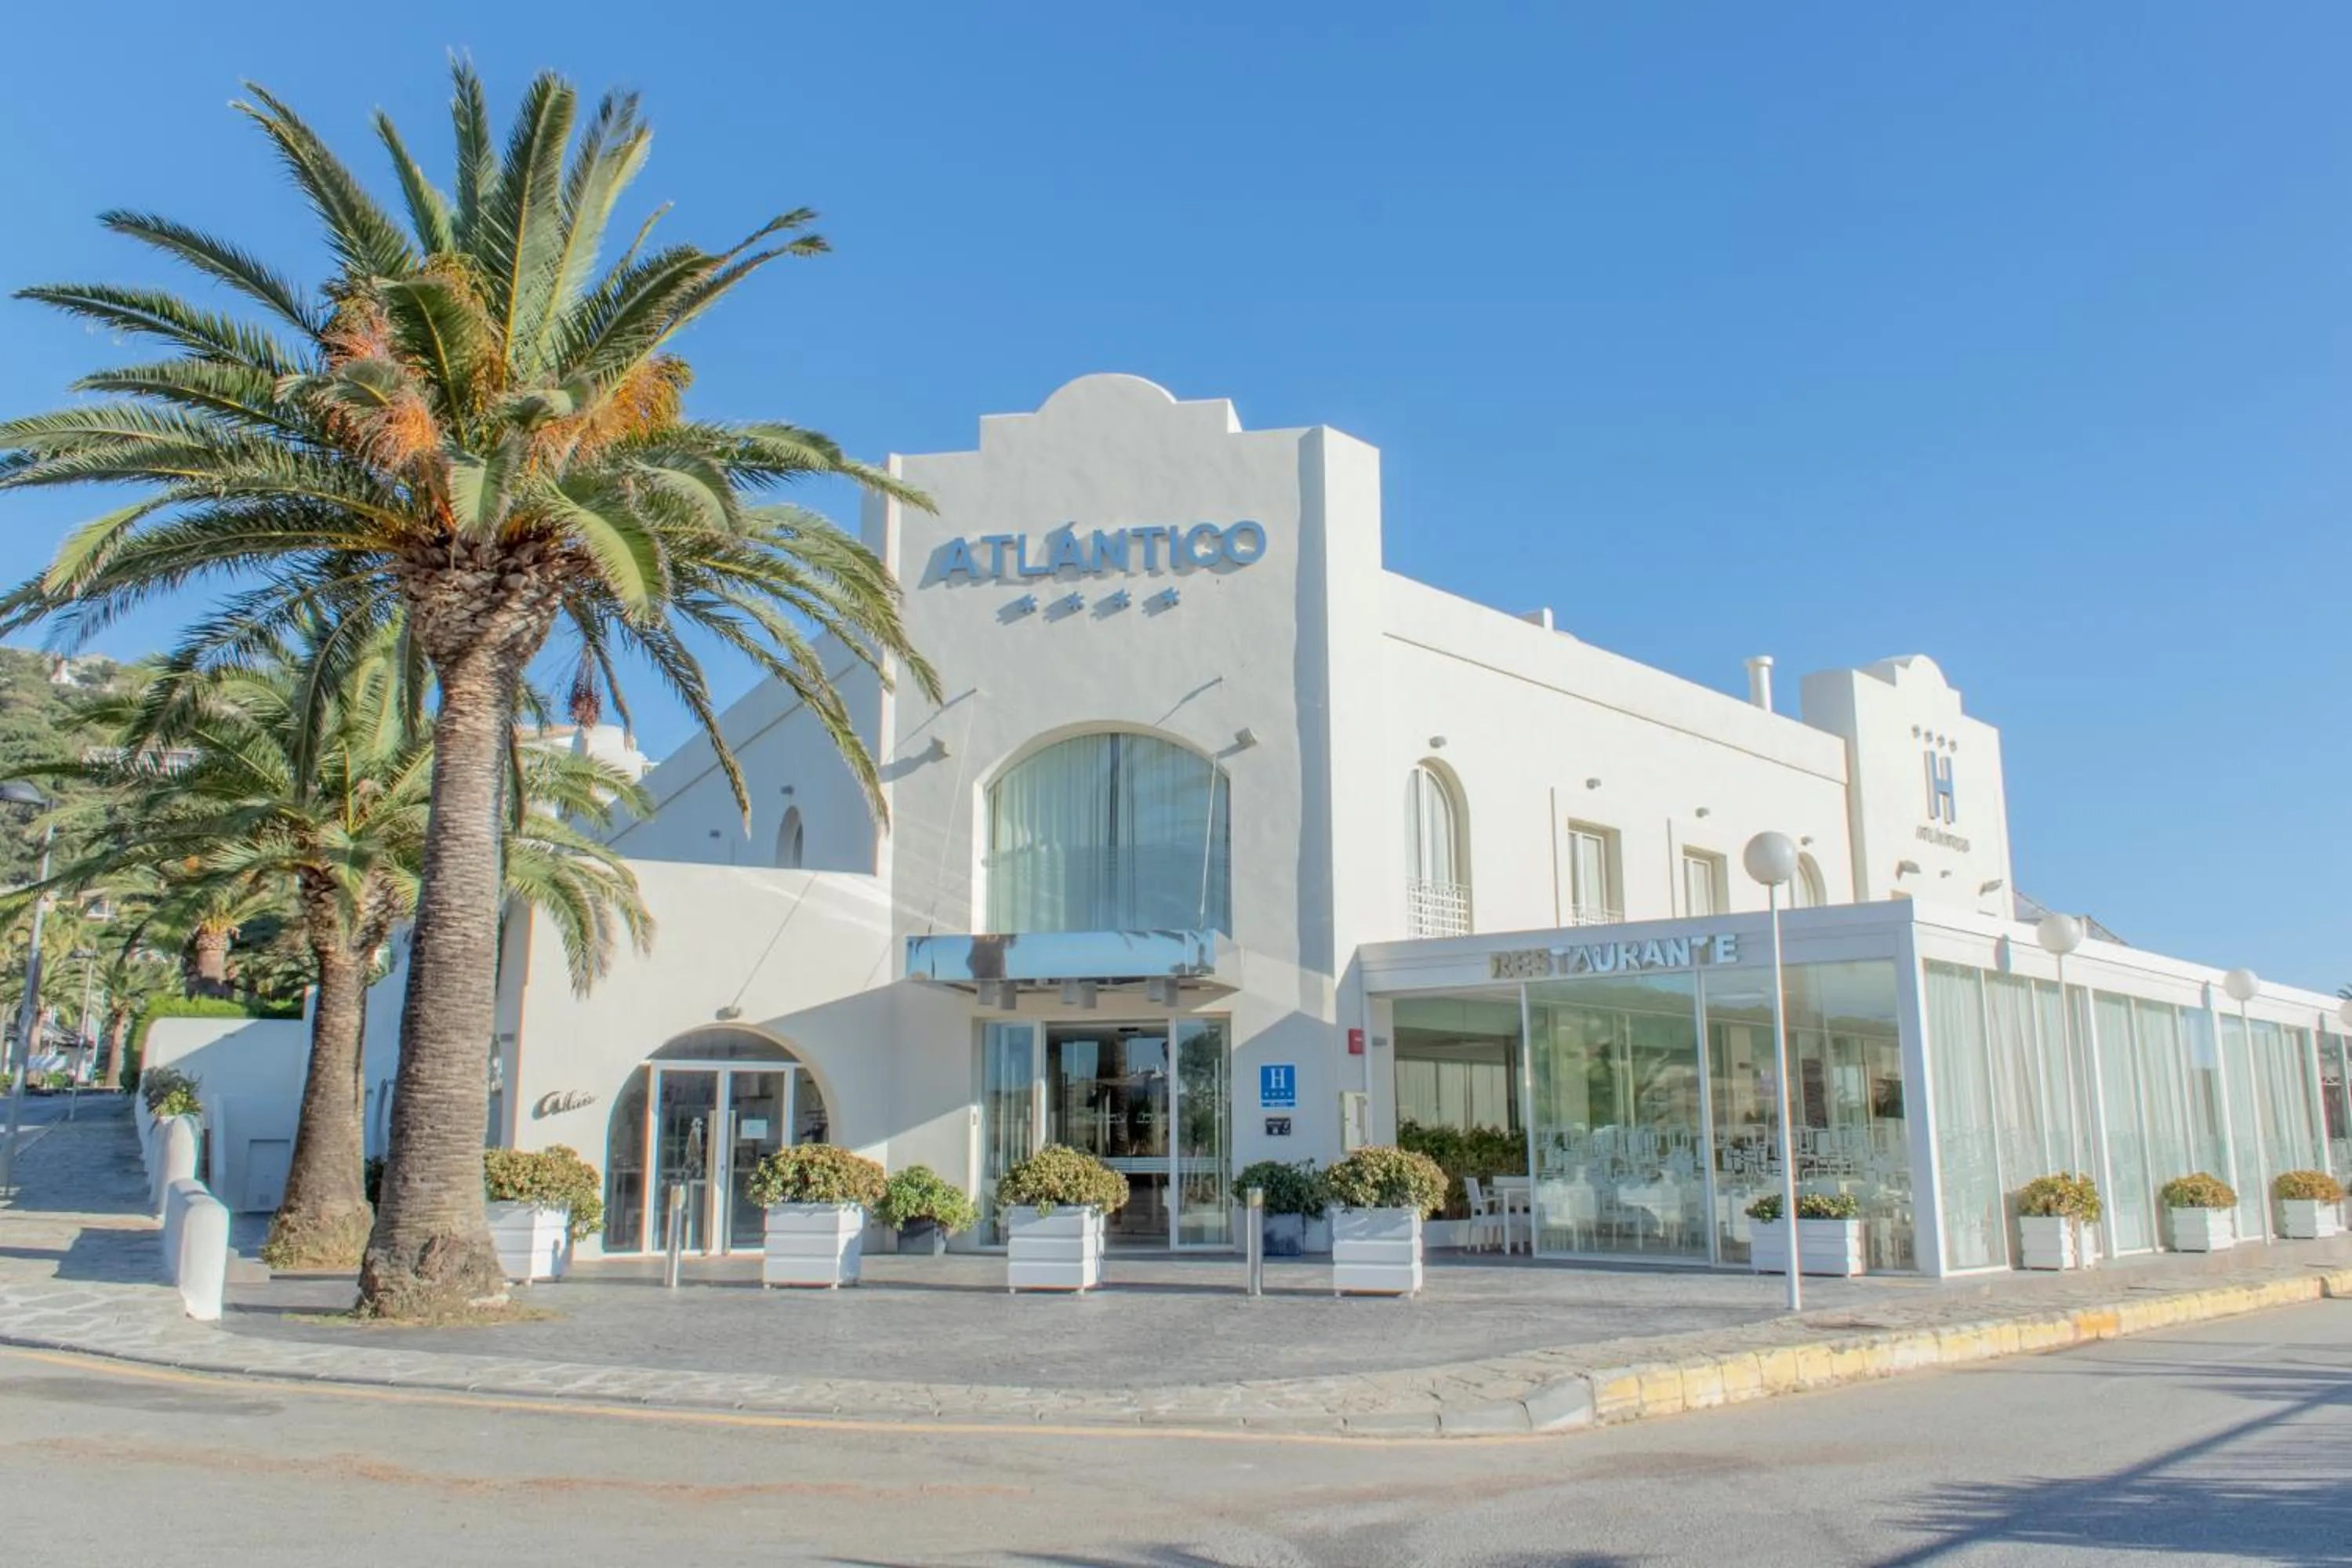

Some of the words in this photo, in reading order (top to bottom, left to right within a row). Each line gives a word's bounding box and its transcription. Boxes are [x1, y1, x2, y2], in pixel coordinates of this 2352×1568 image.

[939, 521, 1267, 581] ATLÁNTICO
[1924, 750, 1955, 825] H
[1490, 933, 1737, 978] RESTAURANTE
[1269, 1068, 1286, 1089] H
